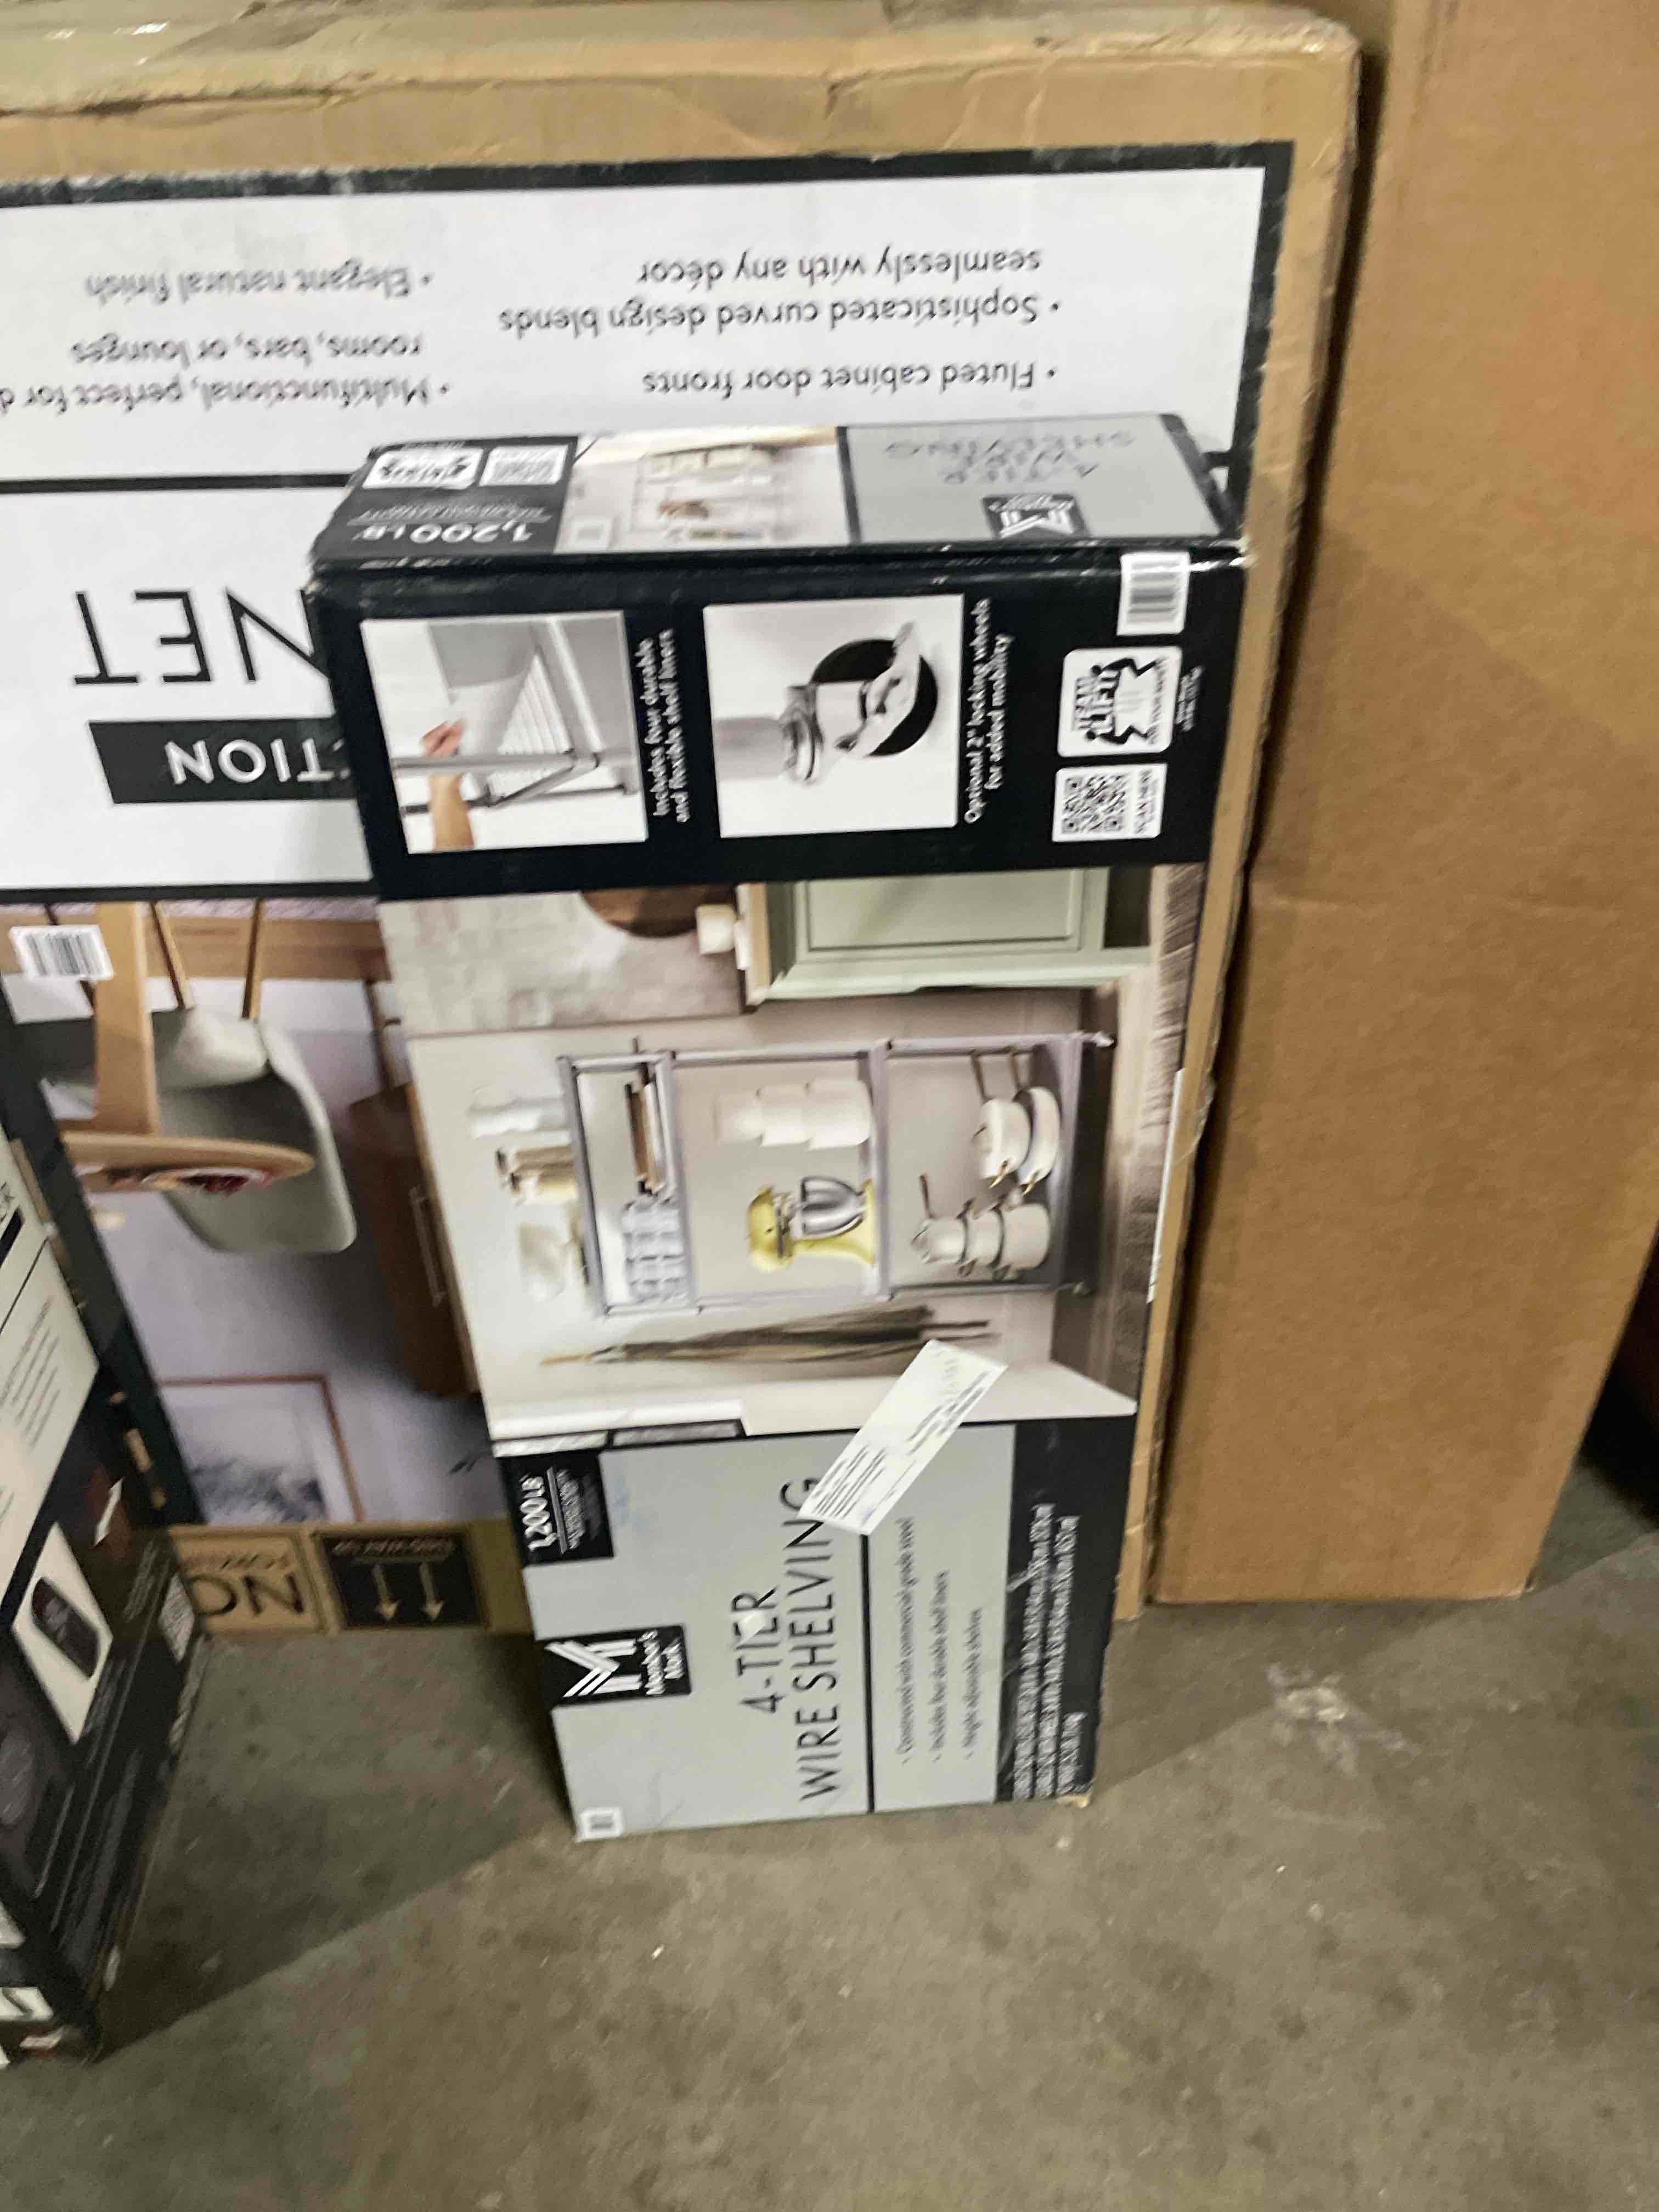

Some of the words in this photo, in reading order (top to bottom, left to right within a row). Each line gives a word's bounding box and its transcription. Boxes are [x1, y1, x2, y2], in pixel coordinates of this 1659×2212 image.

[295, 258, 410, 298] Elegant
[637, 259, 723, 291] décor
[733, 247, 787, 281] any
[798, 252, 865, 287] with
[875, 243, 1041, 284] seamlessly
[86, 274, 169, 306] finish
[178, 270, 285, 304] natural
[498, 306, 598, 340] blends
[608, 296, 706, 336] design
[717, 301, 818, 335] curved
[829, 286, 1038, 331] Sophisticated
[71, 332, 190, 370] lounges
[197, 338, 228, 360] or
[235, 331, 312, 367] bars,
[317, 331, 421, 358] rooms,
[73, 373, 183, 414] perfect
[642, 369, 732, 400] fronts
[741, 368, 811, 397] door
[820, 363, 931, 396] cabinet
[940, 360, 1035, 395] Fluted
[24, 386, 67, 415] for
[964, 751, 988, 823] Optional
[795, 1705, 842, 1801] WIRE
